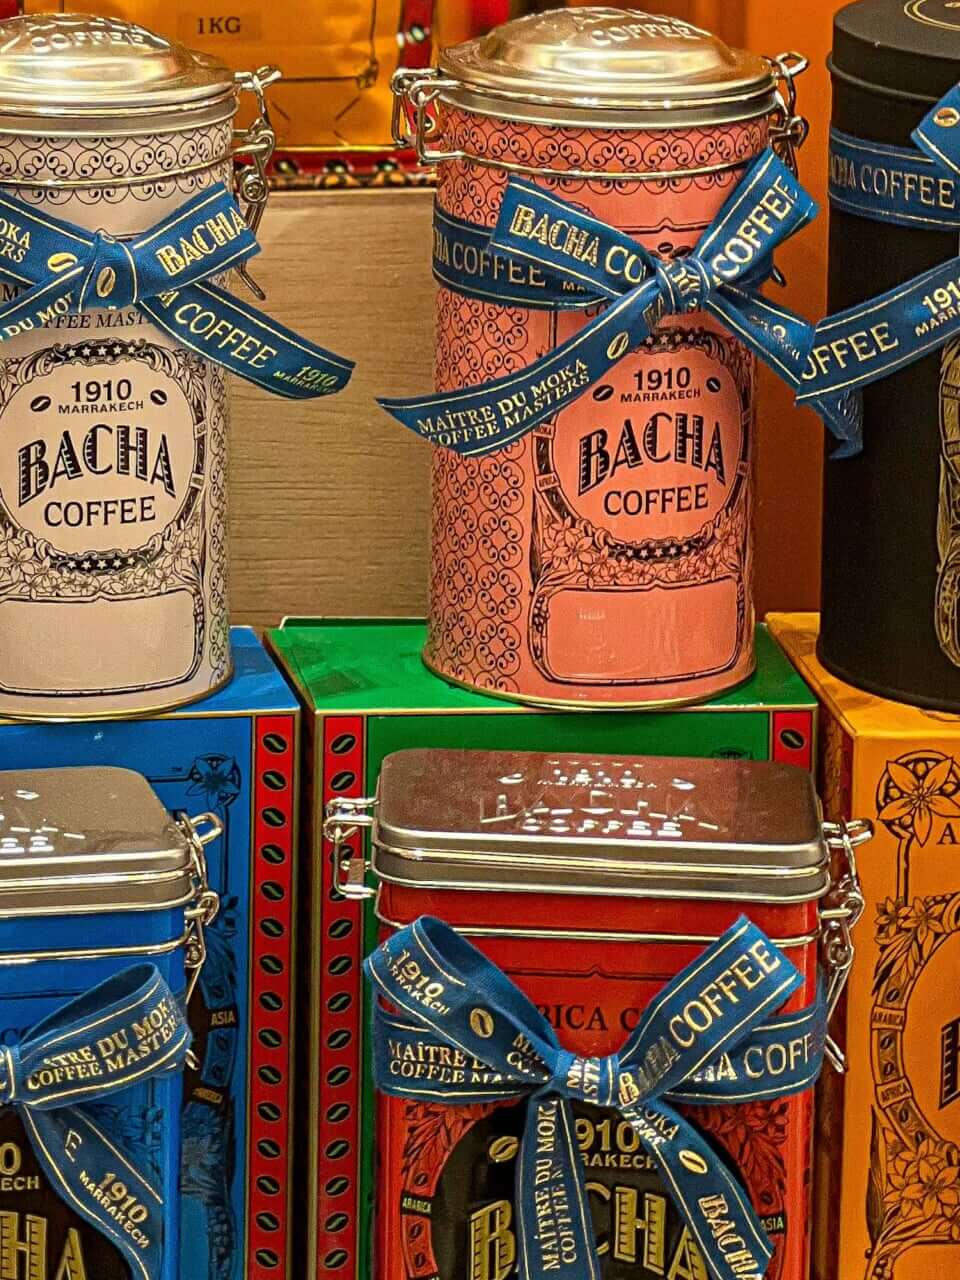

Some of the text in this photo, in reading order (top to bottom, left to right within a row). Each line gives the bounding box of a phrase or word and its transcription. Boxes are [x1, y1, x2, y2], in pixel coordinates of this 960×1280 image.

[197, 16, 241, 35] 1KG
[860, 164, 956, 210] COFFEE
[155, 204, 247, 277] BACHA
[509, 204, 599, 268] BACHA
[712, 175, 800, 279] COFFEE
[922, 273, 960, 316] 191
[4, 317, 35, 337] DU
[174, 302, 339, 388] COFFEE 1910
[71, 379, 132, 403] 1910
[500, 391, 528, 417] DU
[531, 360, 588, 398] MOKA
[620, 389, 701, 403] MARRAKECH
[634, 367, 690, 391] 1910
[58, 400, 144, 414] MARRAKECH
[427, 372, 591, 449] COFFEE MASTERS
[17, 424, 176, 507] BACHA
[578, 412, 726, 497] BACHA
[44, 496, 156, 527] COFFEE
[603, 483, 709, 516] COFFEE
[396, 949, 445, 999] 1910
[670, 939, 782, 1048] COFFEE
[210, 1010, 236, 1026] ASIA
[97, 1029, 130, 1057] DU
[27, 1060, 103, 1090] COFFEE
[390, 1059, 465, 1083] COFFEE
[575, 1118, 640, 1154] 910
[535, 1158, 553, 1186] DU
[79, 1170, 152, 1249] MARRAKECH
[98, 1171, 149, 1224] 1910
